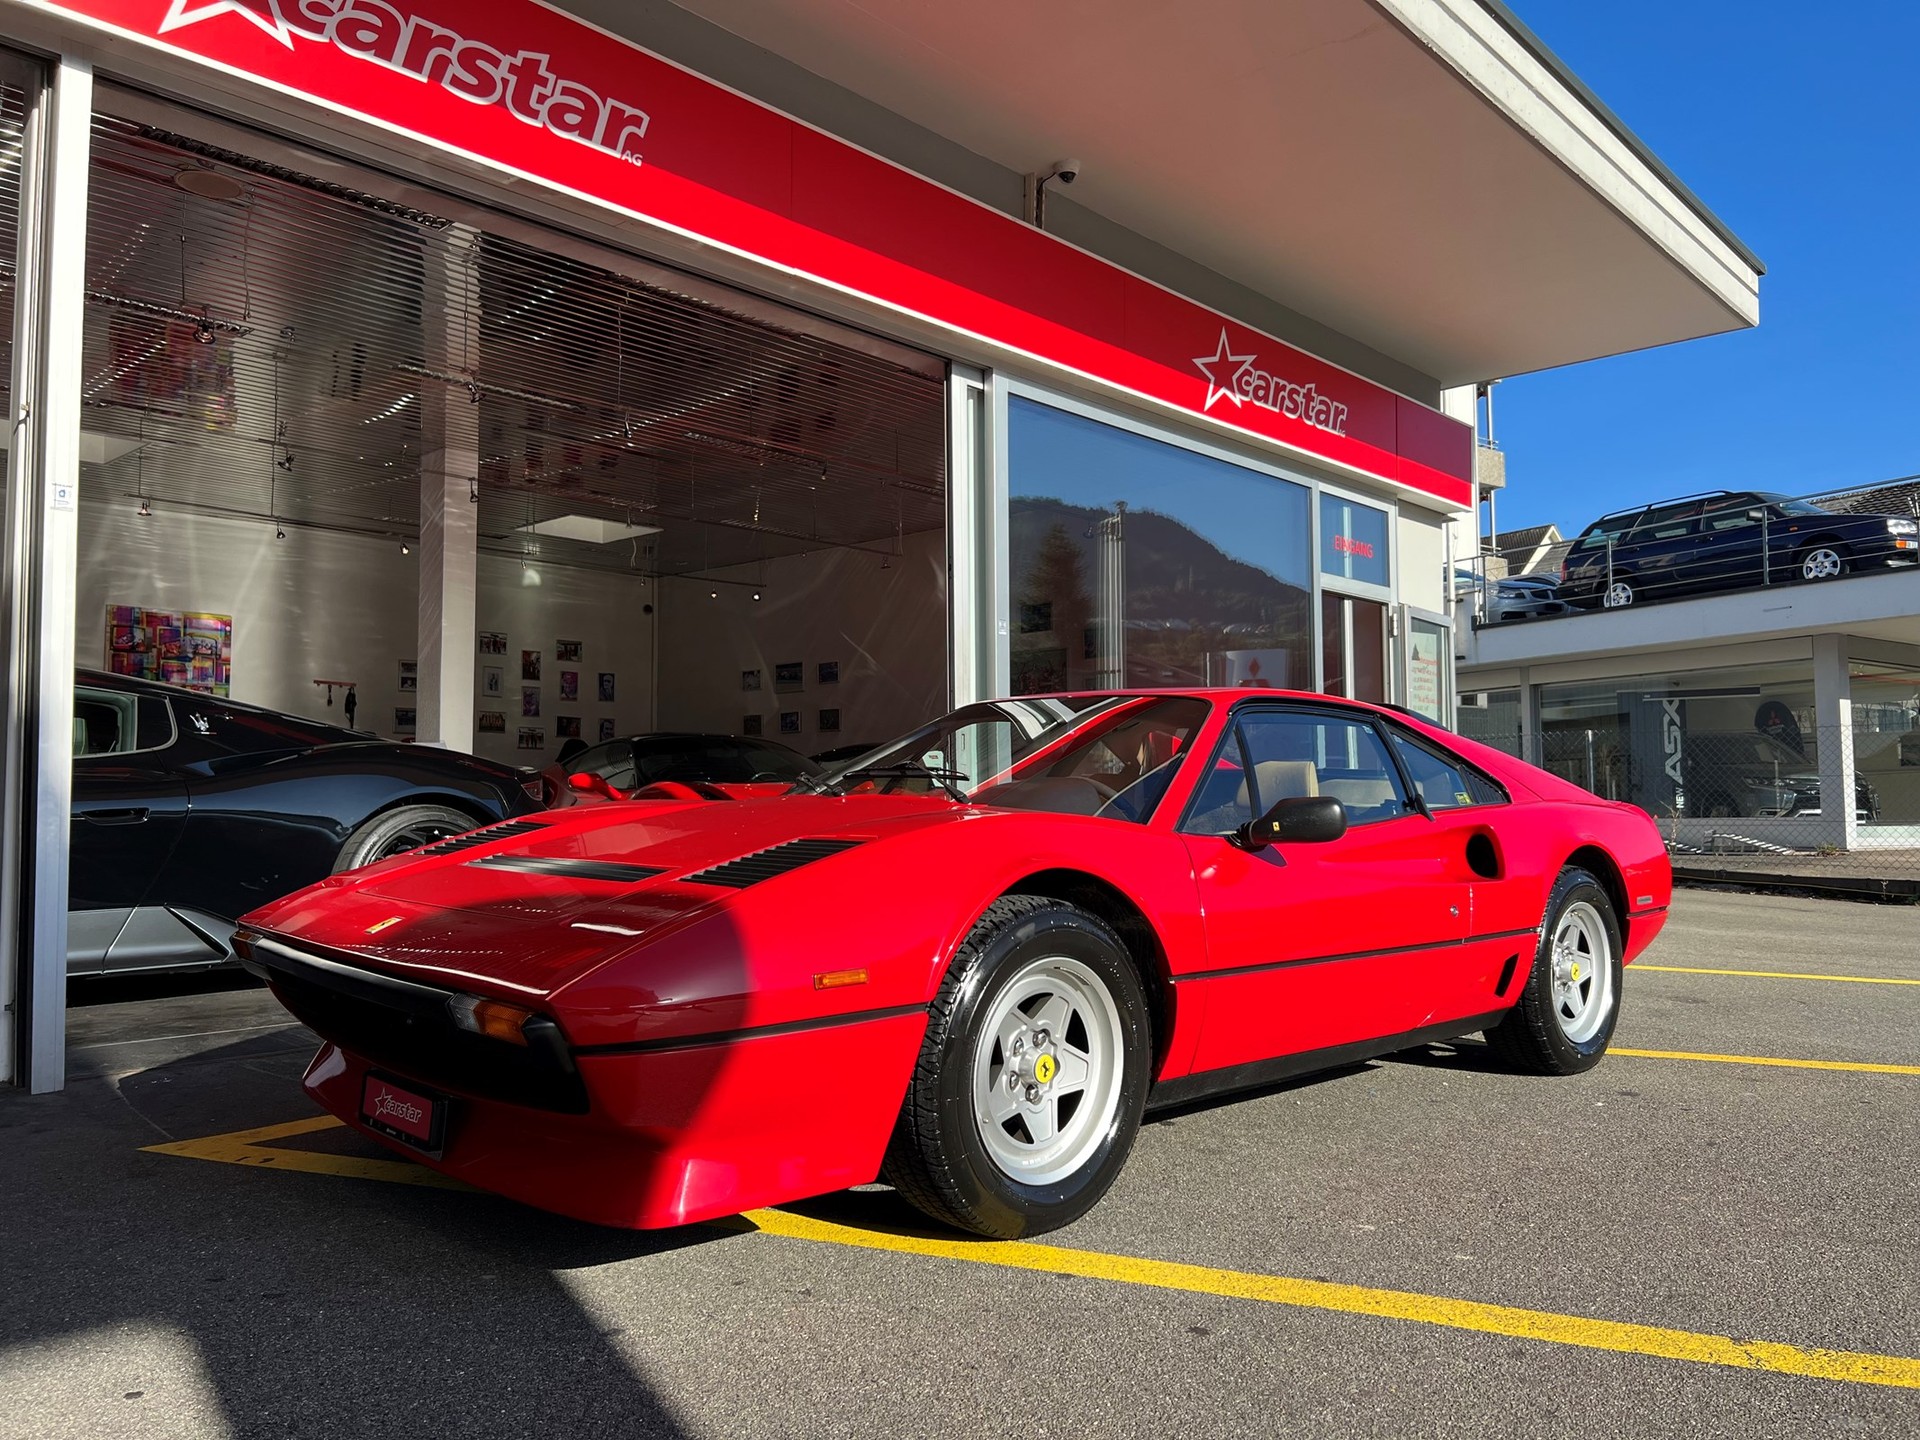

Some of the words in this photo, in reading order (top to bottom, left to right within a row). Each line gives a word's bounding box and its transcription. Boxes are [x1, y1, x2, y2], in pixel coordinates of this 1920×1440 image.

[278, 0, 650, 157] carstar
[621, 149, 643, 167] AG
[1235, 364, 1348, 434] carstar
[1662, 699, 1683, 786] ASX
[1675, 787, 1685, 809] NEW
[384, 1098, 422, 1123] carstar
